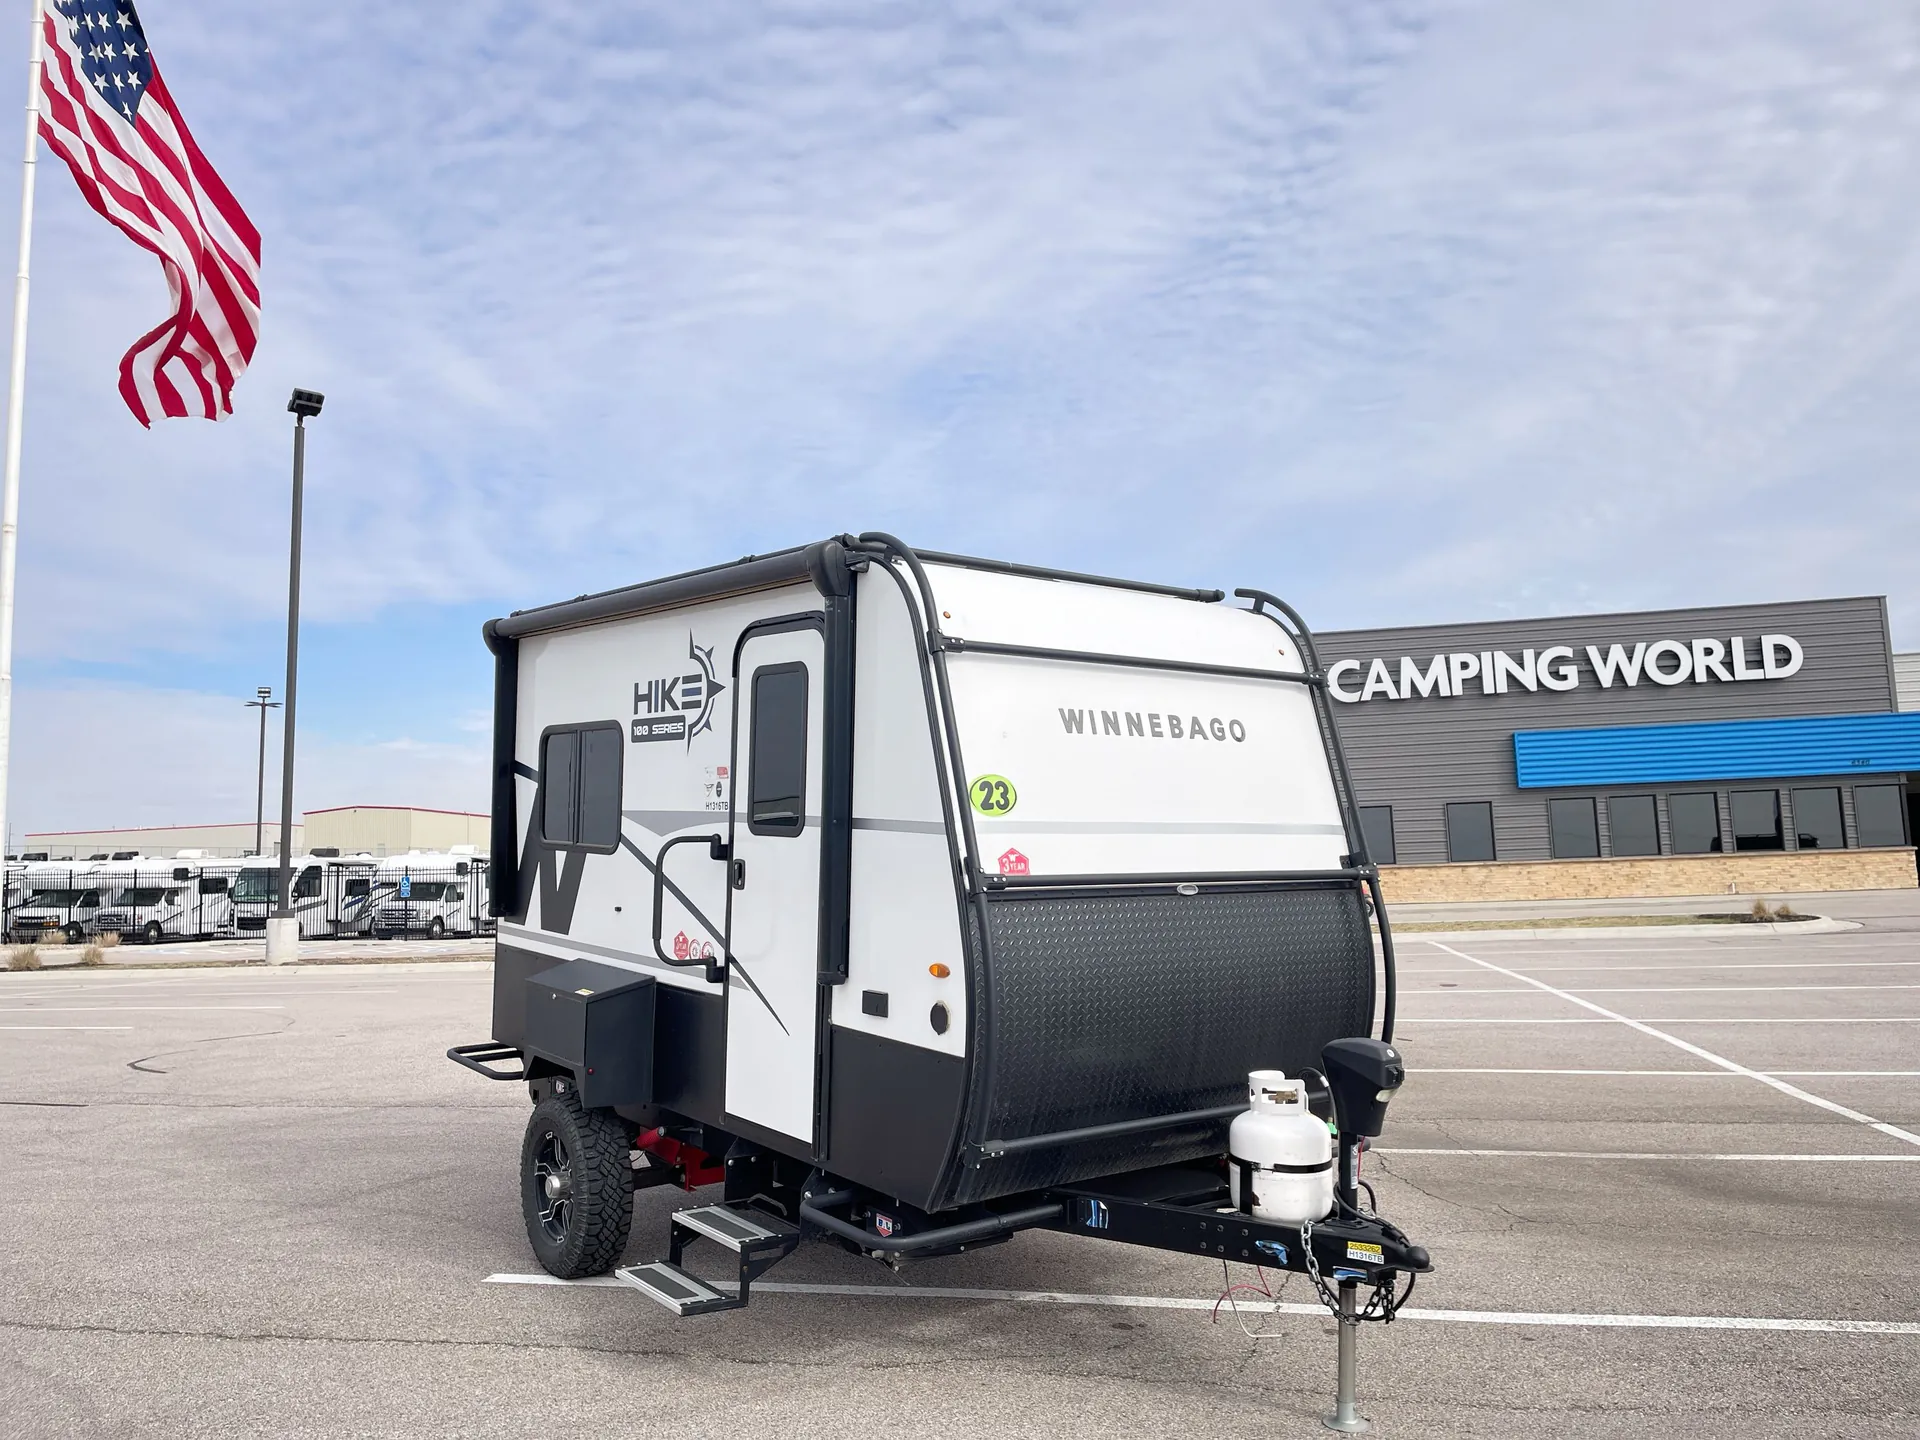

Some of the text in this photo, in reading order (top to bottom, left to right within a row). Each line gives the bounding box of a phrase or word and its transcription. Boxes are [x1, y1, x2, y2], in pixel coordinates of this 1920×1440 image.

[1327, 634, 1804, 703] CAMPING WORLD
[633, 673, 703, 715] HIKE
[633, 722, 684, 736] 100 SERIES
[1058, 708, 1246, 743] WINNEBAGO
[979, 780, 1010, 811] 23
[1002, 858, 1025, 873] 3 YEAR
[1349, 1250, 1383, 1263] H1316TB
